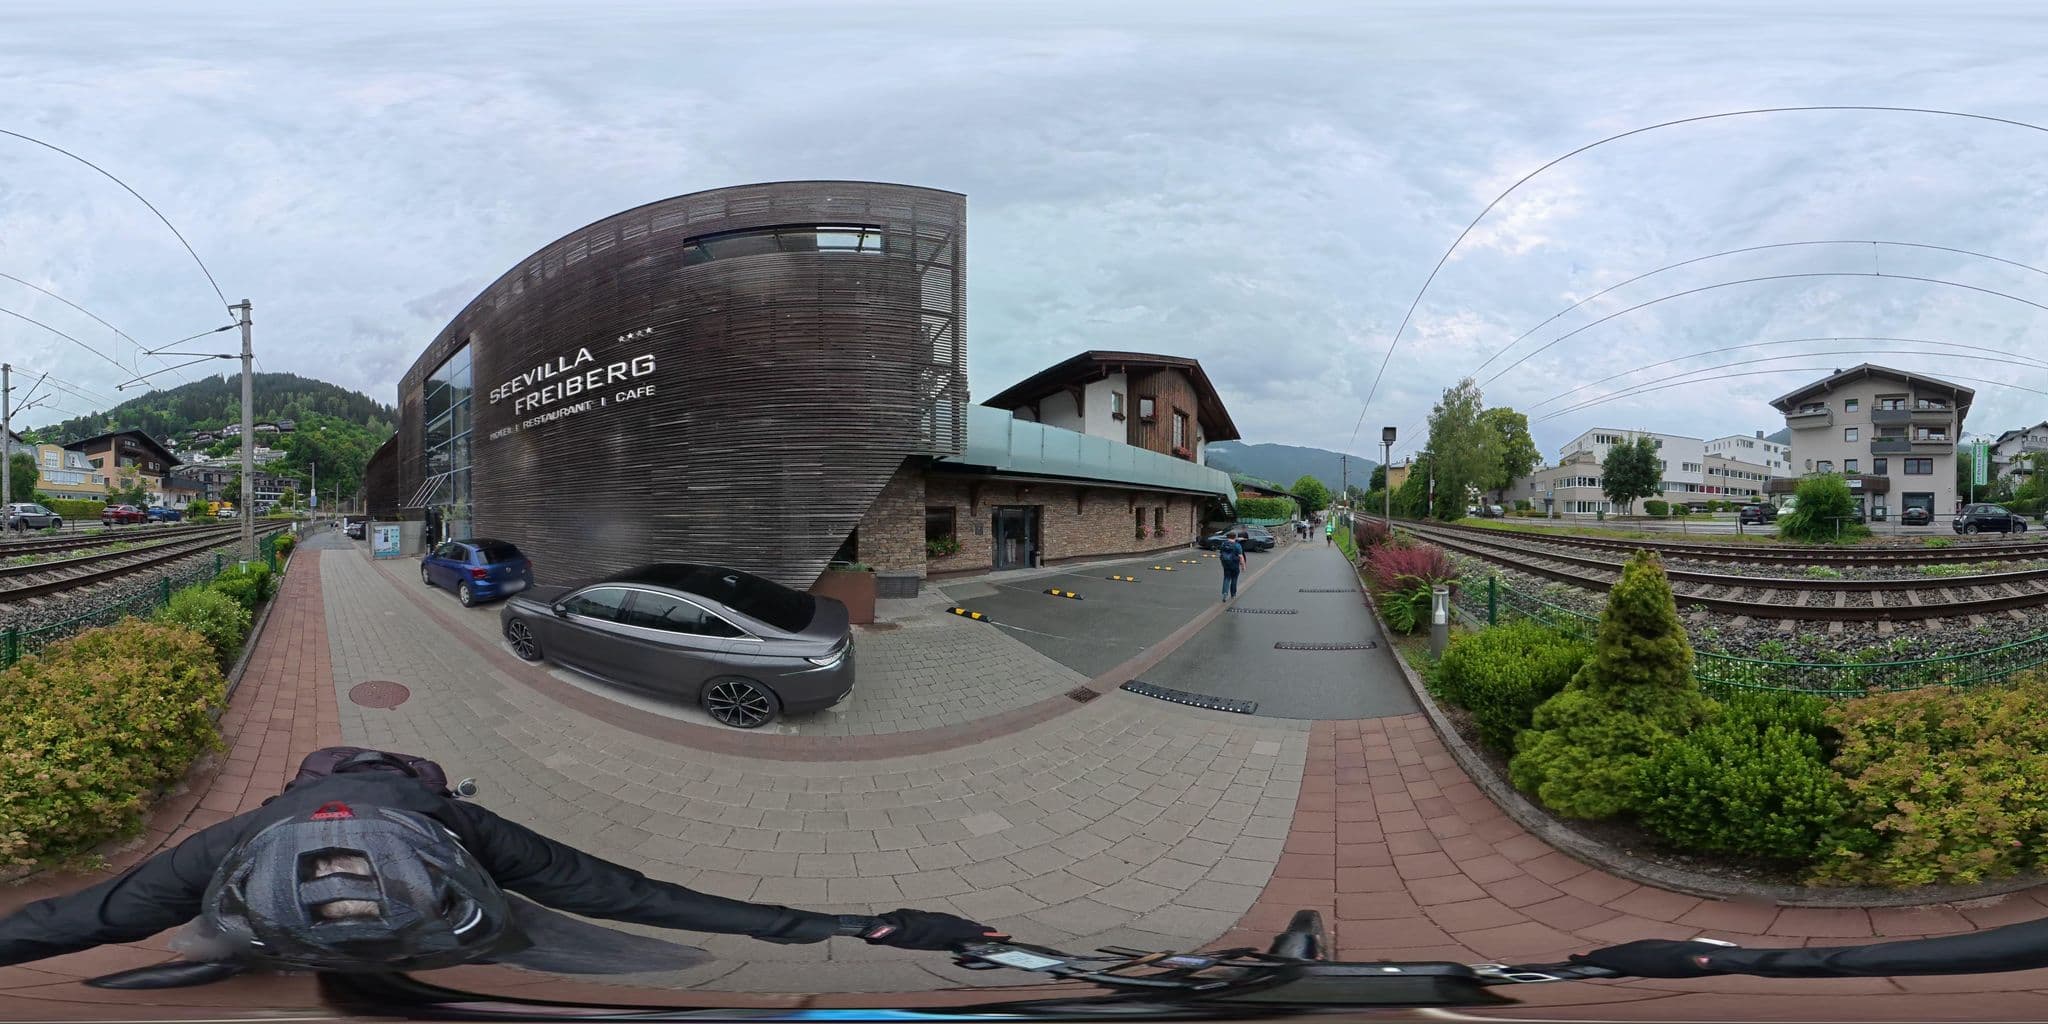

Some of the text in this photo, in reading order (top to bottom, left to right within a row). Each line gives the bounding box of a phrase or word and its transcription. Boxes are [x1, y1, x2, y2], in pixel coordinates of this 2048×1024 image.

[490, 347, 595, 404] SEEVILLA
[515, 354, 656, 415] FREIBERG
[522, 400, 593, 429] RESTAURANT
[615, 384, 656, 402] CAFE
